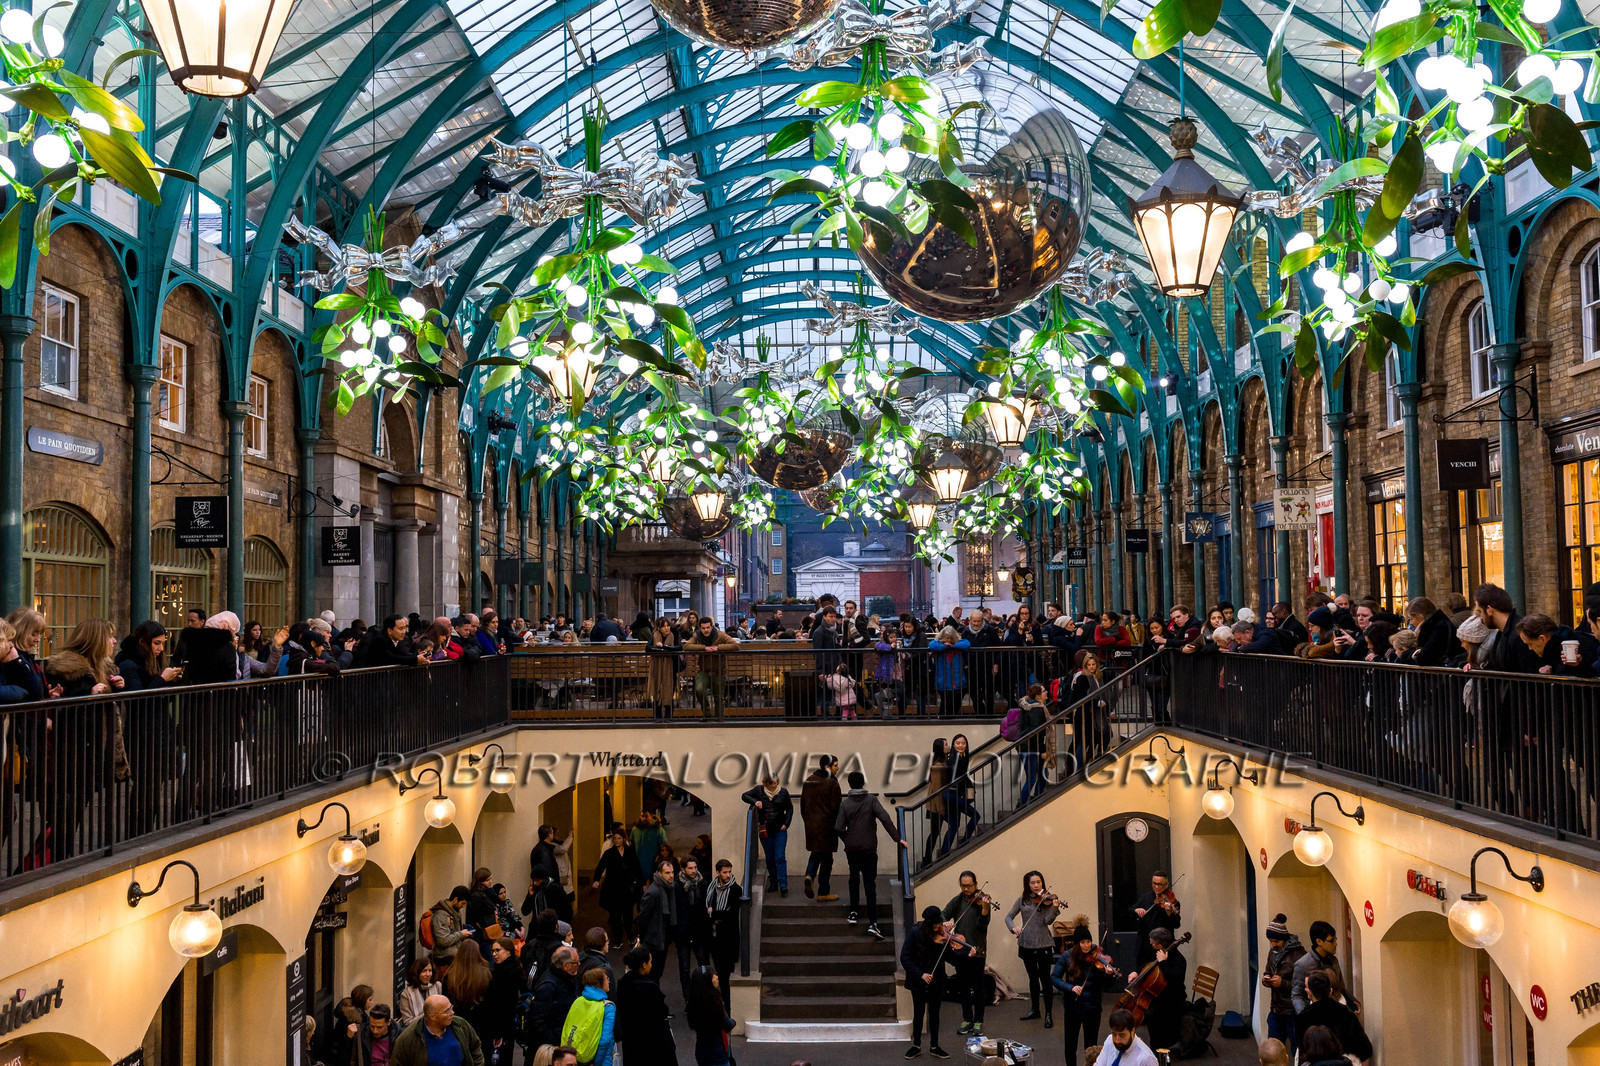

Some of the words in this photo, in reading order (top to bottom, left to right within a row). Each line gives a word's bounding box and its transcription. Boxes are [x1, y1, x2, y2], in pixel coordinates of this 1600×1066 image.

[38, 436, 47, 445] LE
[48, 439, 62, 449] PAIN
[64, 442, 96, 456] QUOTIDIEN
[1381, 479, 1405, 498] Vench
[589, 752, 663, 768] Whittard
[219, 876, 264, 921] Italiani
[1530, 993, 1545, 1011] WC
[1483, 1010, 1493, 1026] WC
